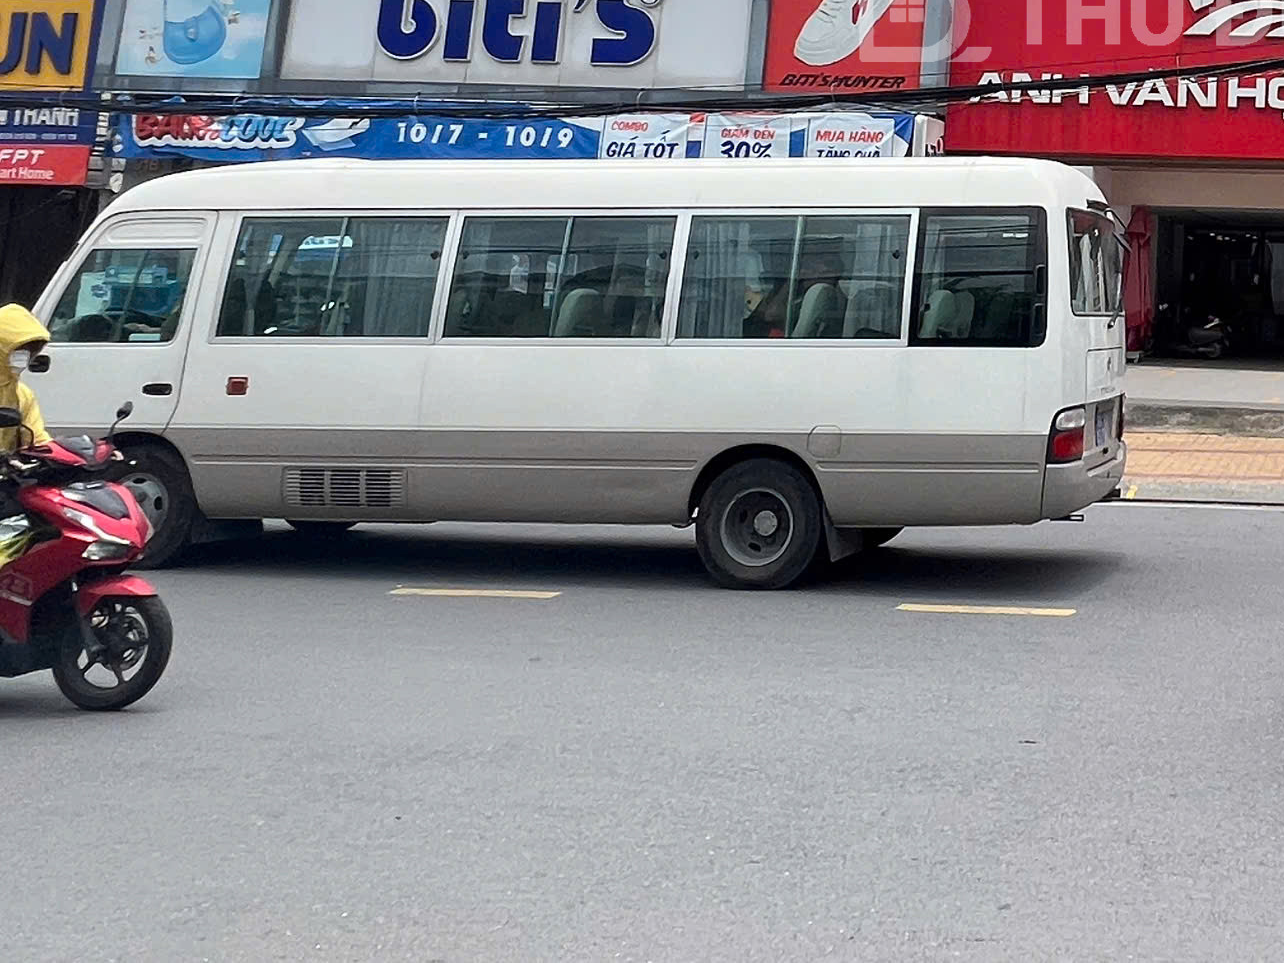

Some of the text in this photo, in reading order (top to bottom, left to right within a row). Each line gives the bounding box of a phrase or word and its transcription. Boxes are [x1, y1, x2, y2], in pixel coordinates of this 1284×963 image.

[606, 130, 679, 158] GIÁ TỐT
[815, 128, 884, 143] MUA HÀNG
